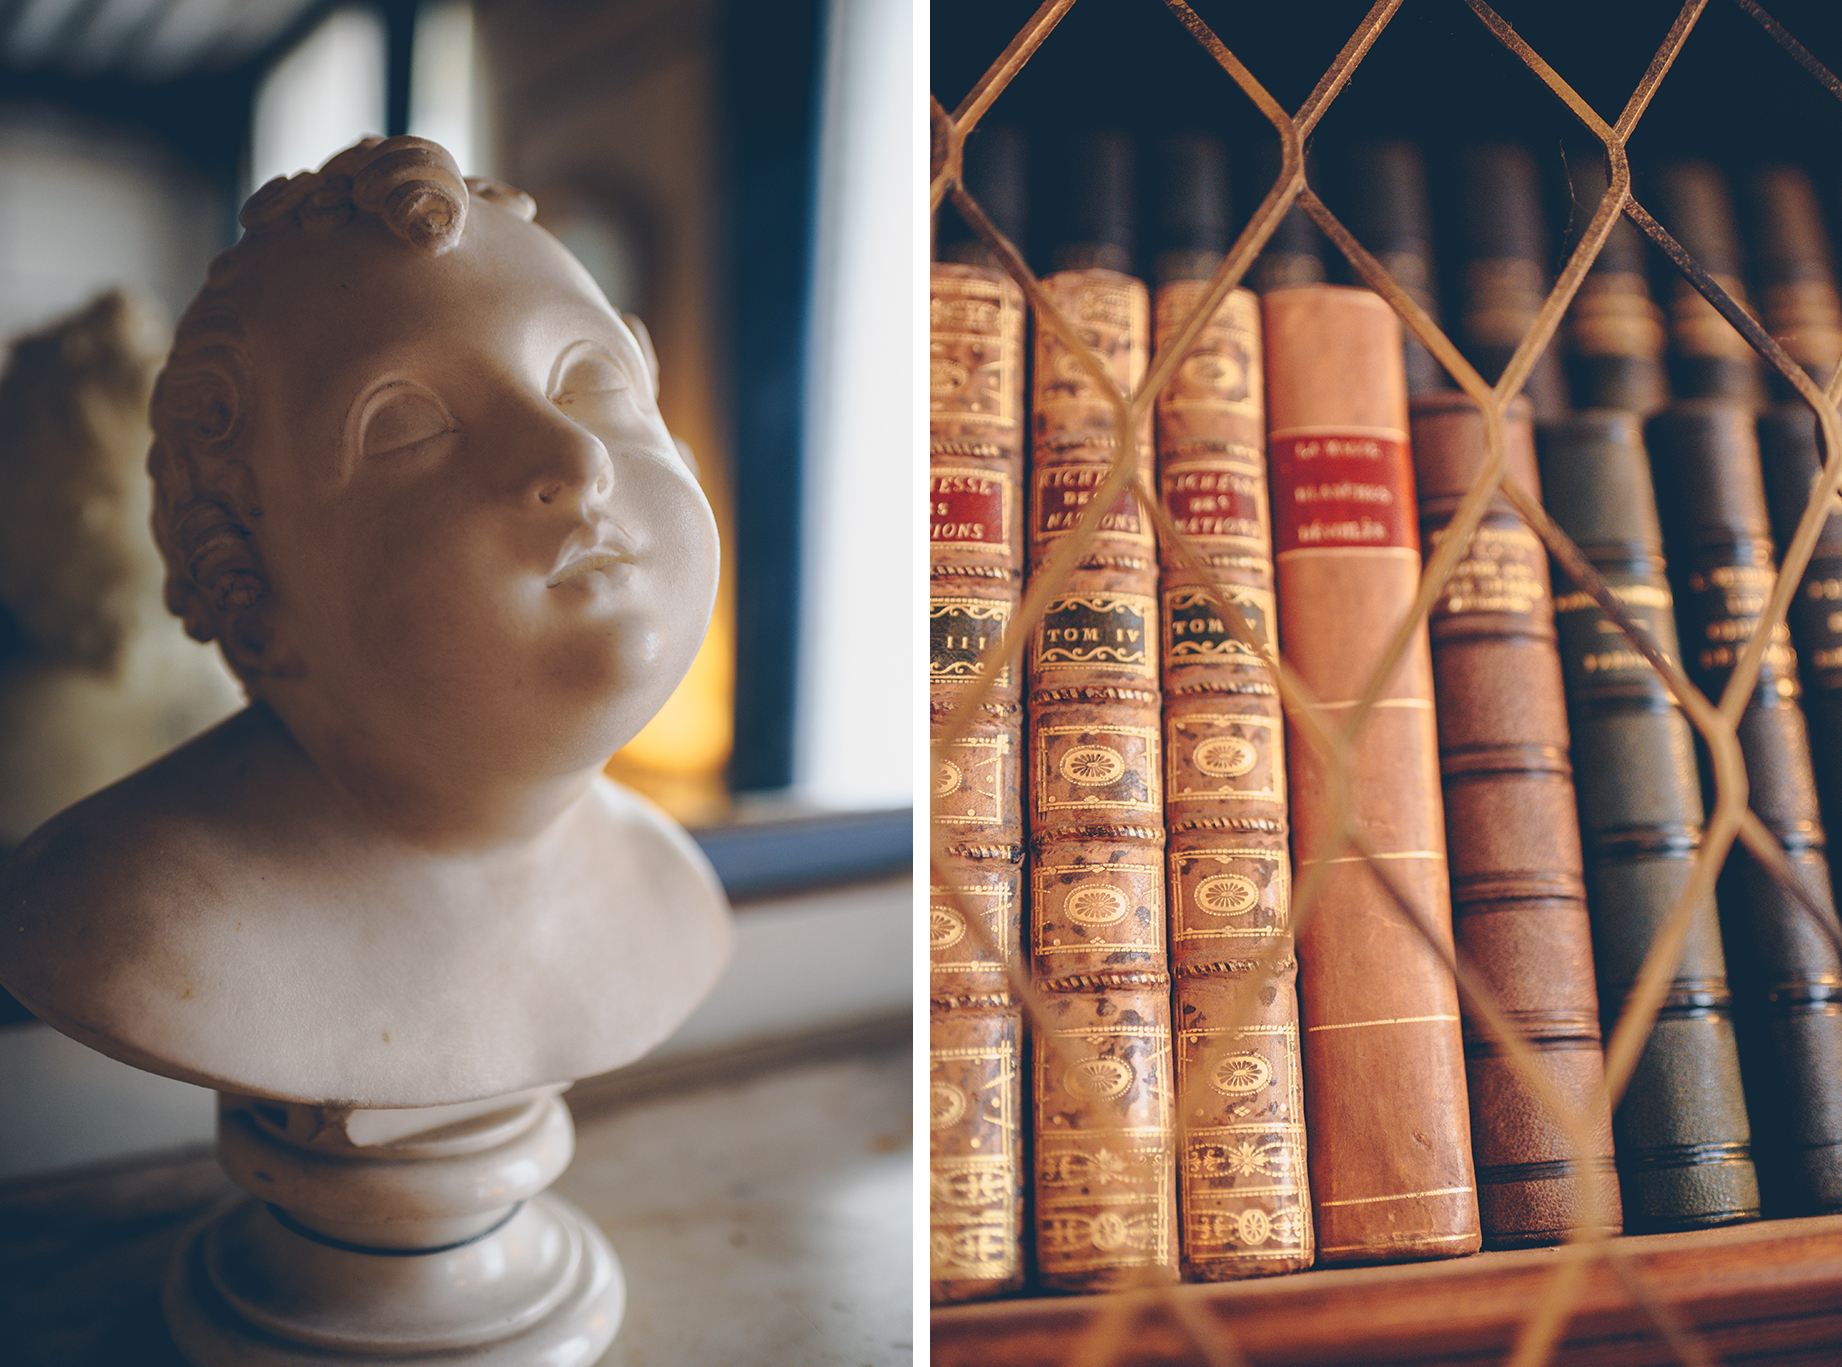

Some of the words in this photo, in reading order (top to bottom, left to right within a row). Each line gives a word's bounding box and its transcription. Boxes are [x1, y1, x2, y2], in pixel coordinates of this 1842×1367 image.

[1063, 490, 1099, 506] DE
[930, 523, 985, 539] IONS
[1172, 618, 1226, 635] TOM
[947, 636, 986, 650] III
[1047, 628, 1099, 642] TOM
[1116, 628, 1140, 642] IV
